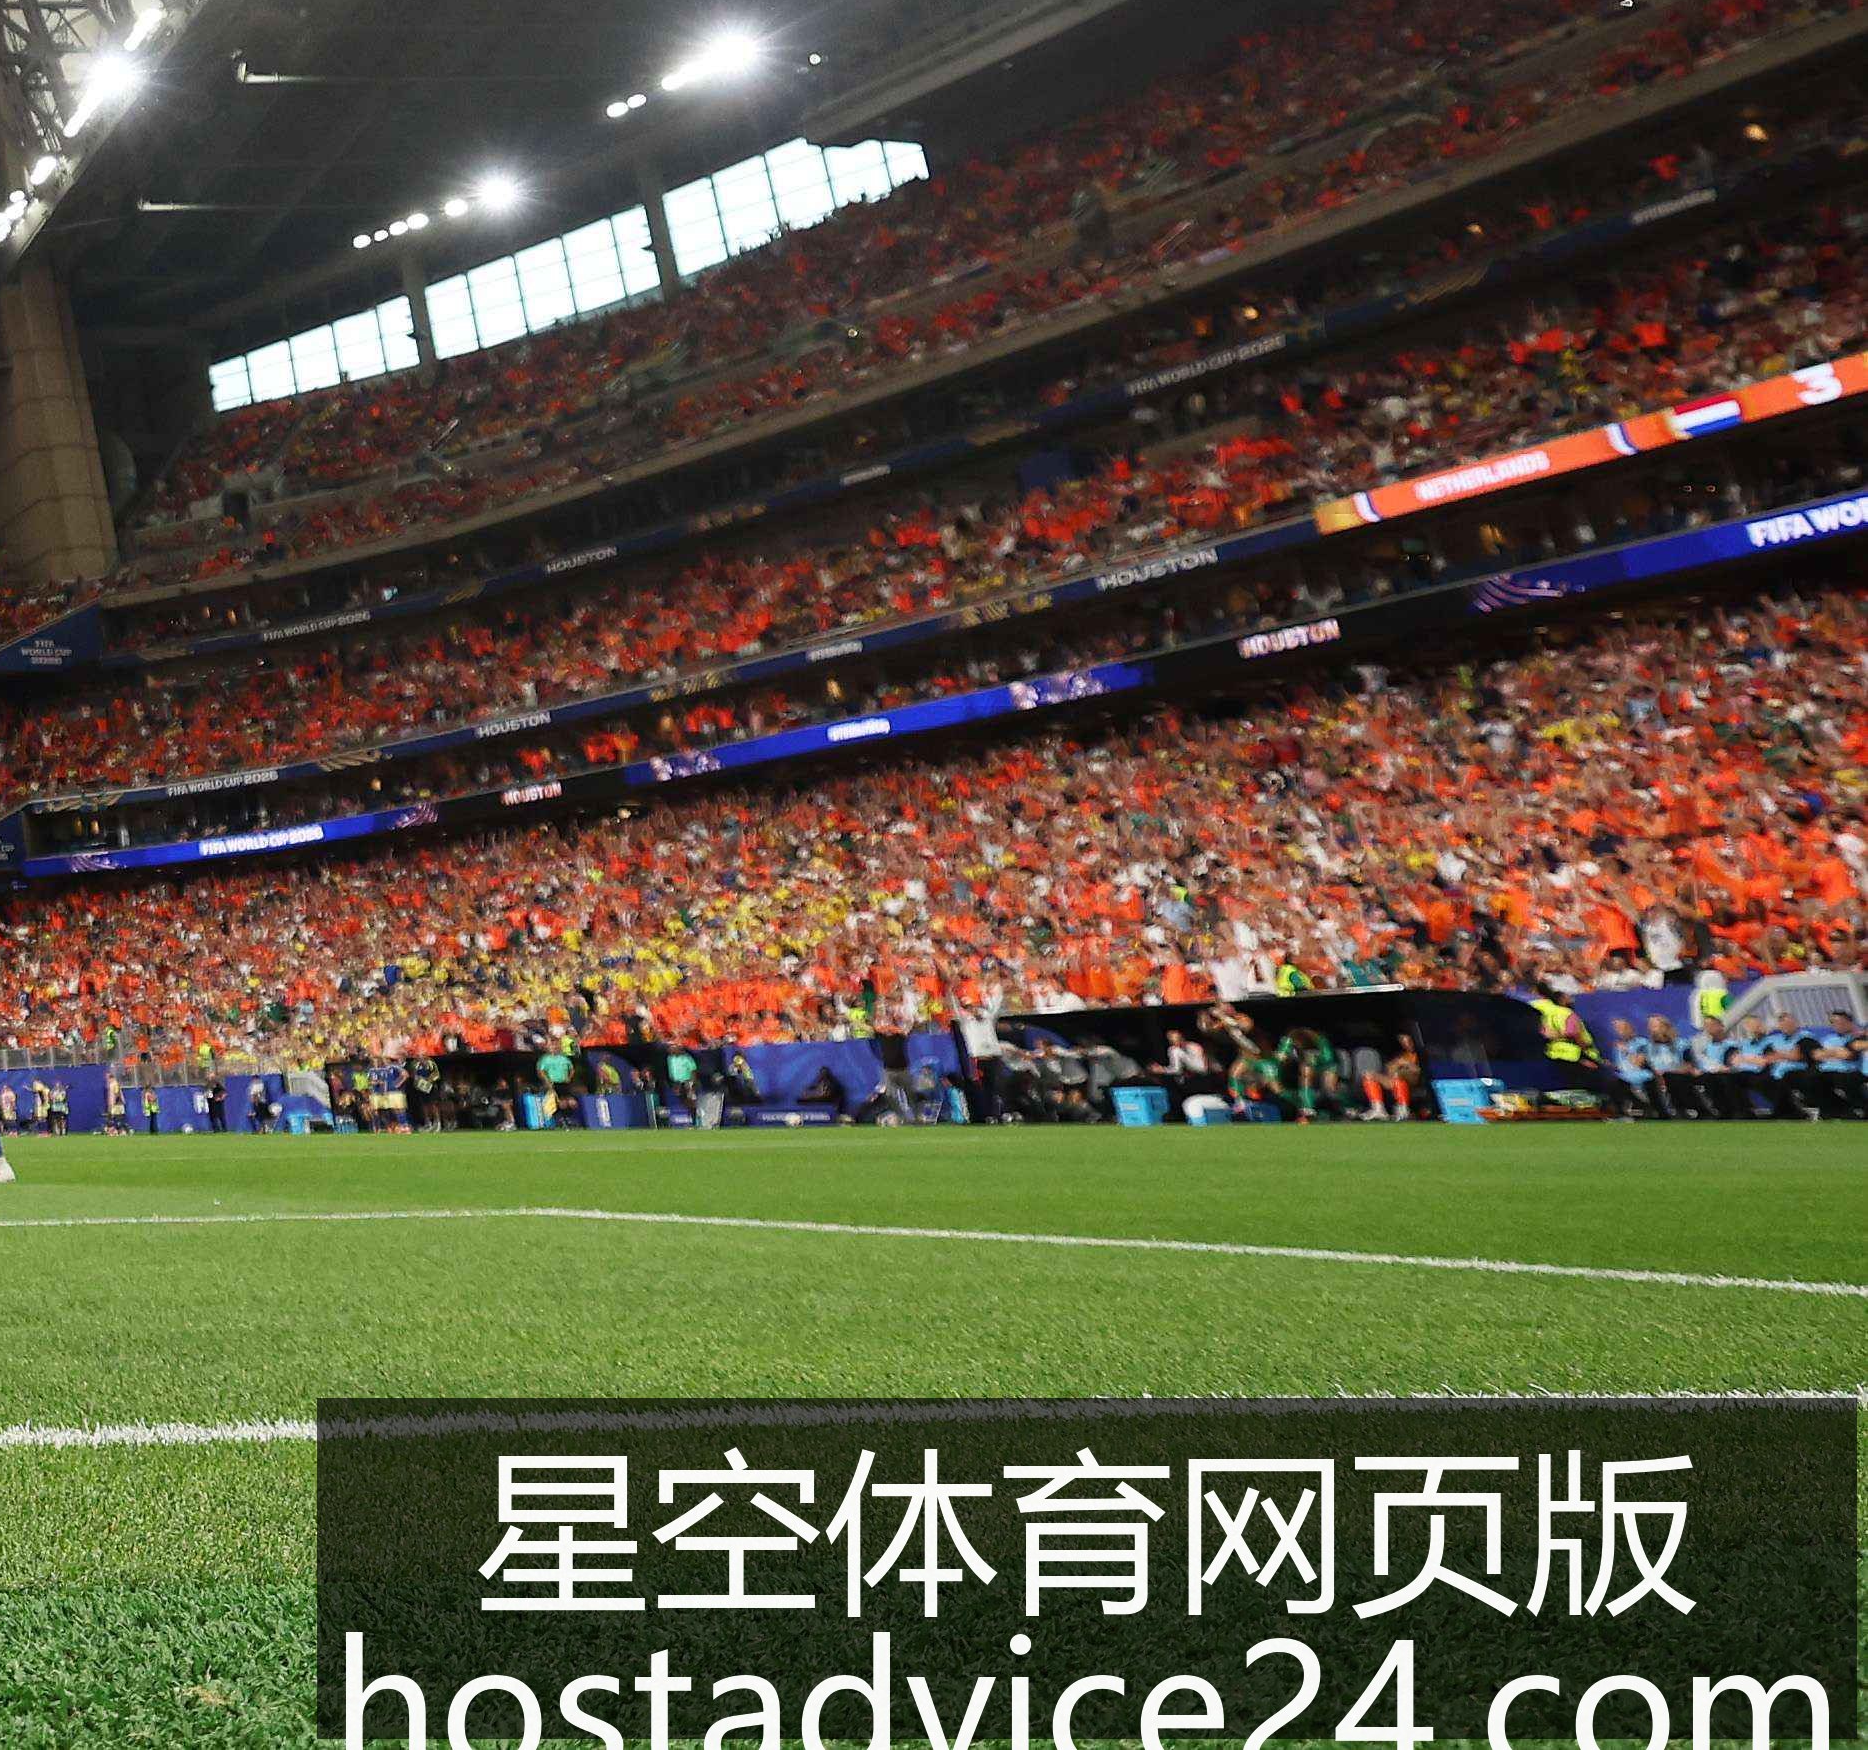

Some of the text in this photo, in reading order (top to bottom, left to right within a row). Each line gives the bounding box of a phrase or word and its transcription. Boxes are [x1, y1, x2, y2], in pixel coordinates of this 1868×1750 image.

[1793, 363, 1843, 404] 3
[1745, 512, 1814, 548] FIFA
[547, 546, 617, 574] HOUSTON
[1096, 549, 1218, 591] HOUSTON
[477, 712, 551, 738] HOUSTON
[167, 770, 279, 796] FIFA WORLD CUP 2026
[201, 838, 227, 856] FIFA
[227, 832, 265, 853] WORLD
[265, 830, 289, 846] CUP
